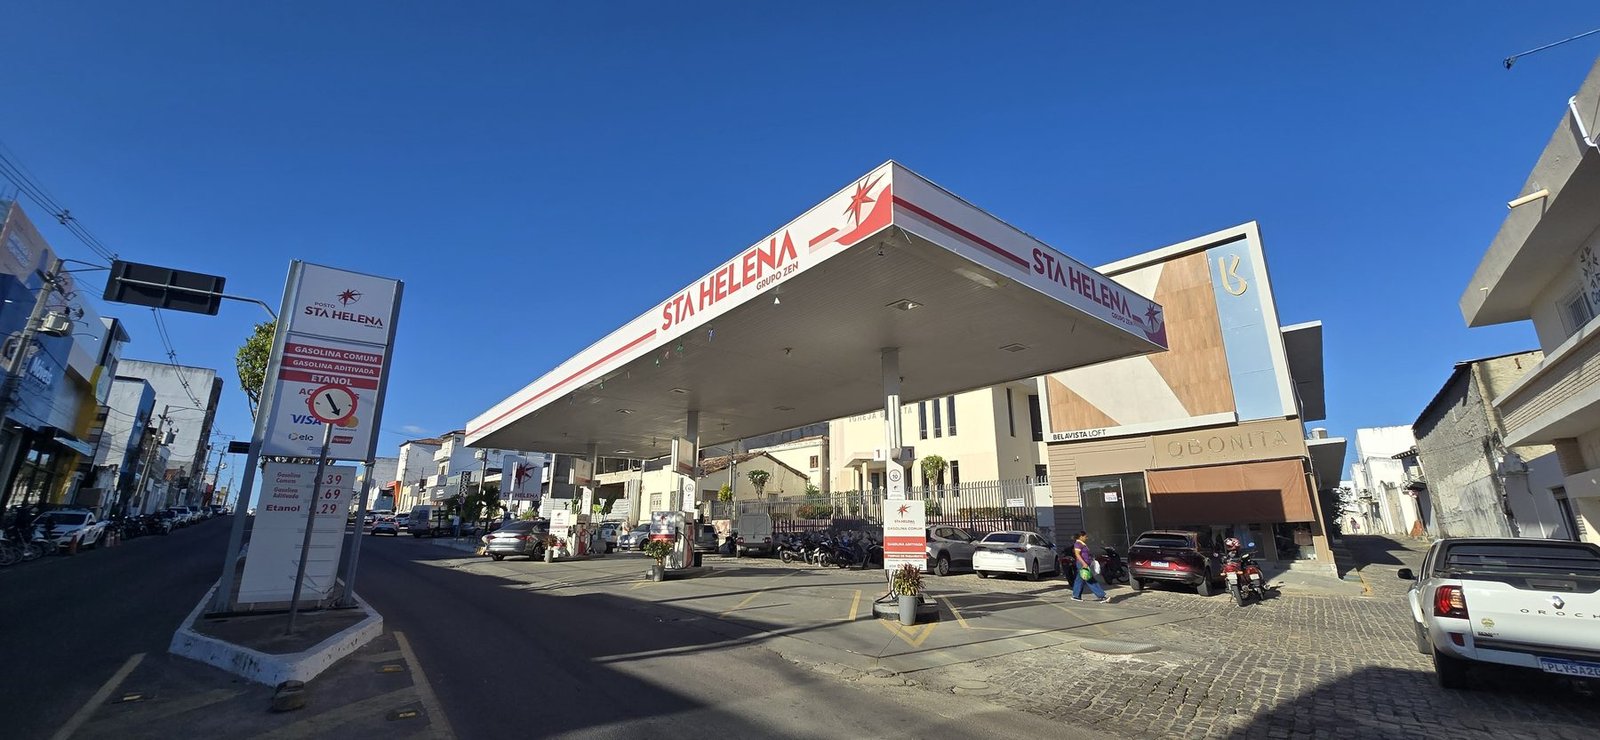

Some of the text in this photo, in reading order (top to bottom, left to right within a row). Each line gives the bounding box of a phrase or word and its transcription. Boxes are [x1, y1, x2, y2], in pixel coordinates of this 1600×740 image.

[662, 229, 798, 331] STA HELENA
[756, 261, 799, 291] GRUPO ZEN
[1032, 247, 1132, 319] STA HELENA
[314, 301, 336, 309] POSTO
[304, 306, 383, 326] STA HELENA
[294, 346, 378, 363] GASOLINA COMUM
[292, 359, 375, 376] GASOLINA ADITIVADA
[311, 375, 353, 387] ETANOL
[290, 413, 322, 426] VISA
[299, 434, 314, 442] elo
[1088, 429, 1107, 438] LOFT
[875, 449, 881, 459] 1
[907, 448, 913, 458] 1
[265, 504, 301, 512] Etanol
